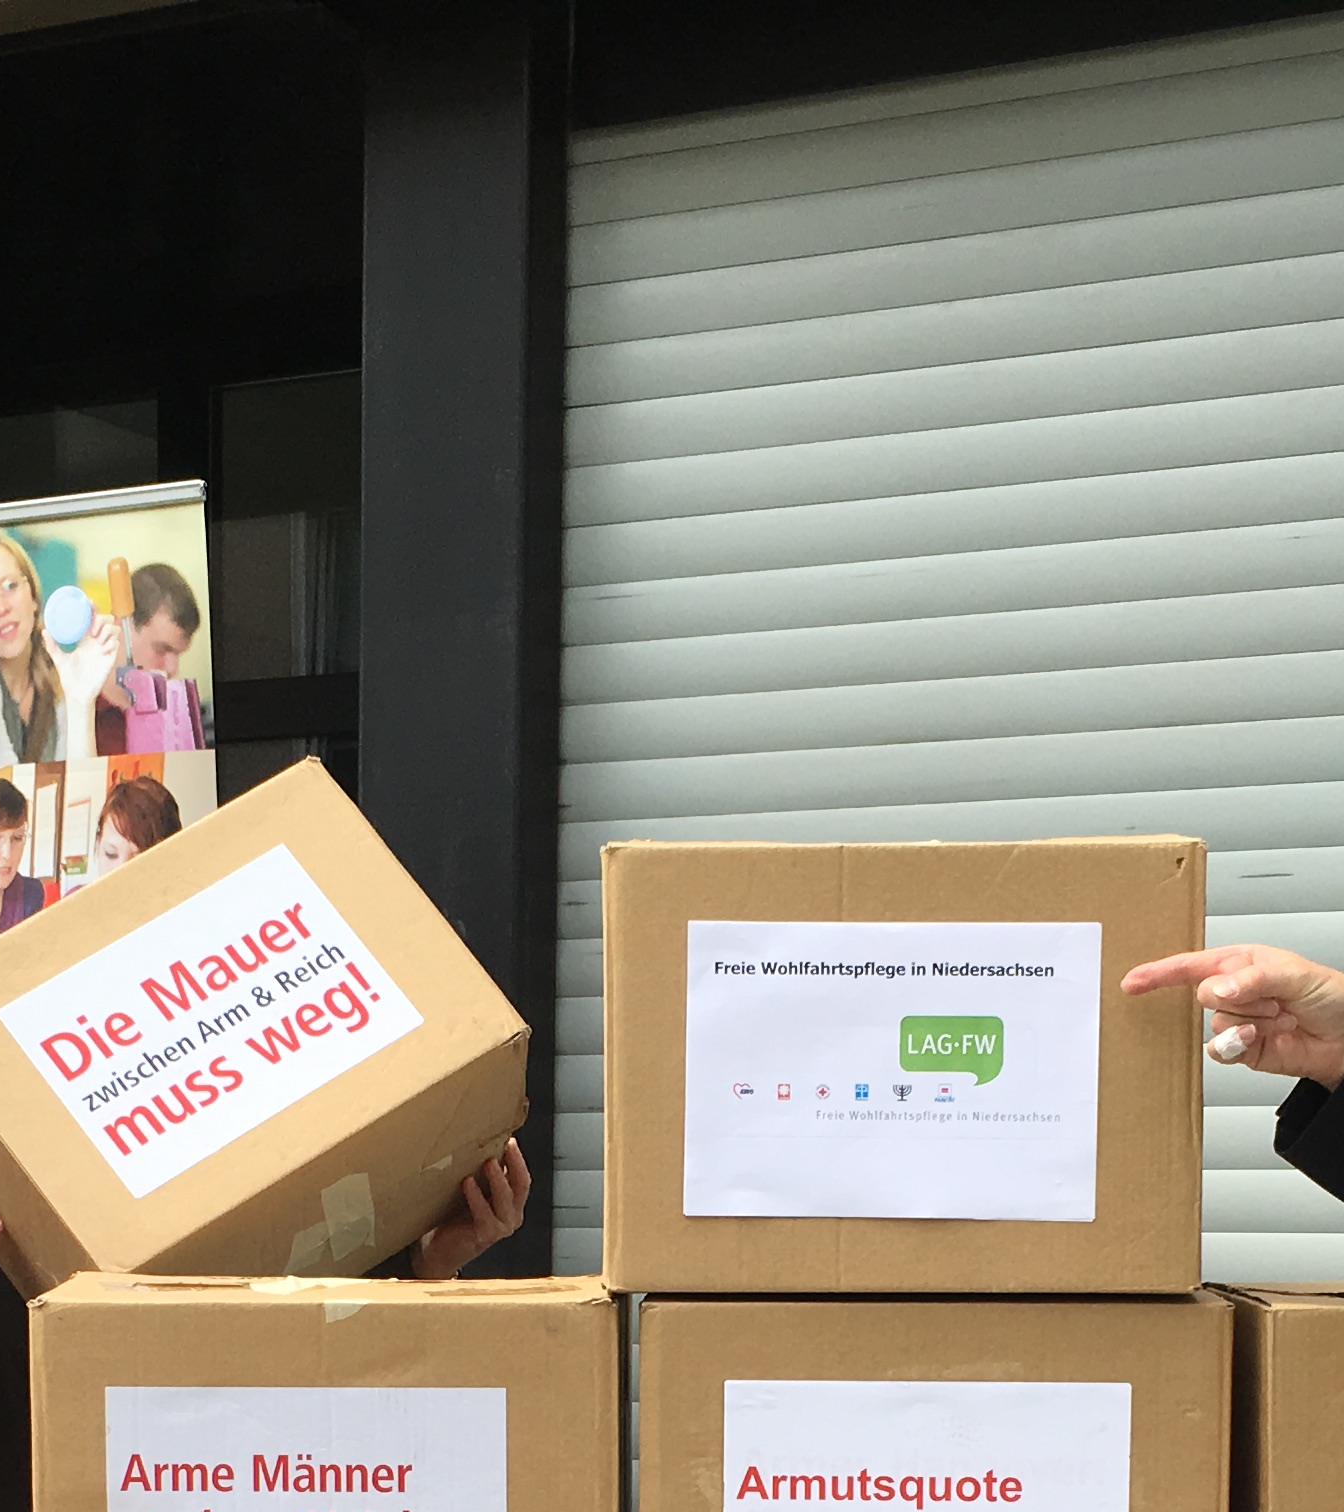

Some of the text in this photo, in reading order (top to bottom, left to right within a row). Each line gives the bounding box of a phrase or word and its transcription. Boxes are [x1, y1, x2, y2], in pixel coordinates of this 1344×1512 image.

[40, 902, 313, 1082] Die Mauer
[714, 961, 1054, 979] Freie Wohlfahrtspflege in Niedersachsen
[82, 941, 346, 1113] zwischen Arm & Reich
[102, 961, 382, 1157] muss weg!
[815, 1109, 1061, 1123] Freie Wohlfahrtspflege in Niedersachsen
[120, 1453, 413, 1494] Arme Männer
[736, 1465, 1023, 1511] Armutsquote
